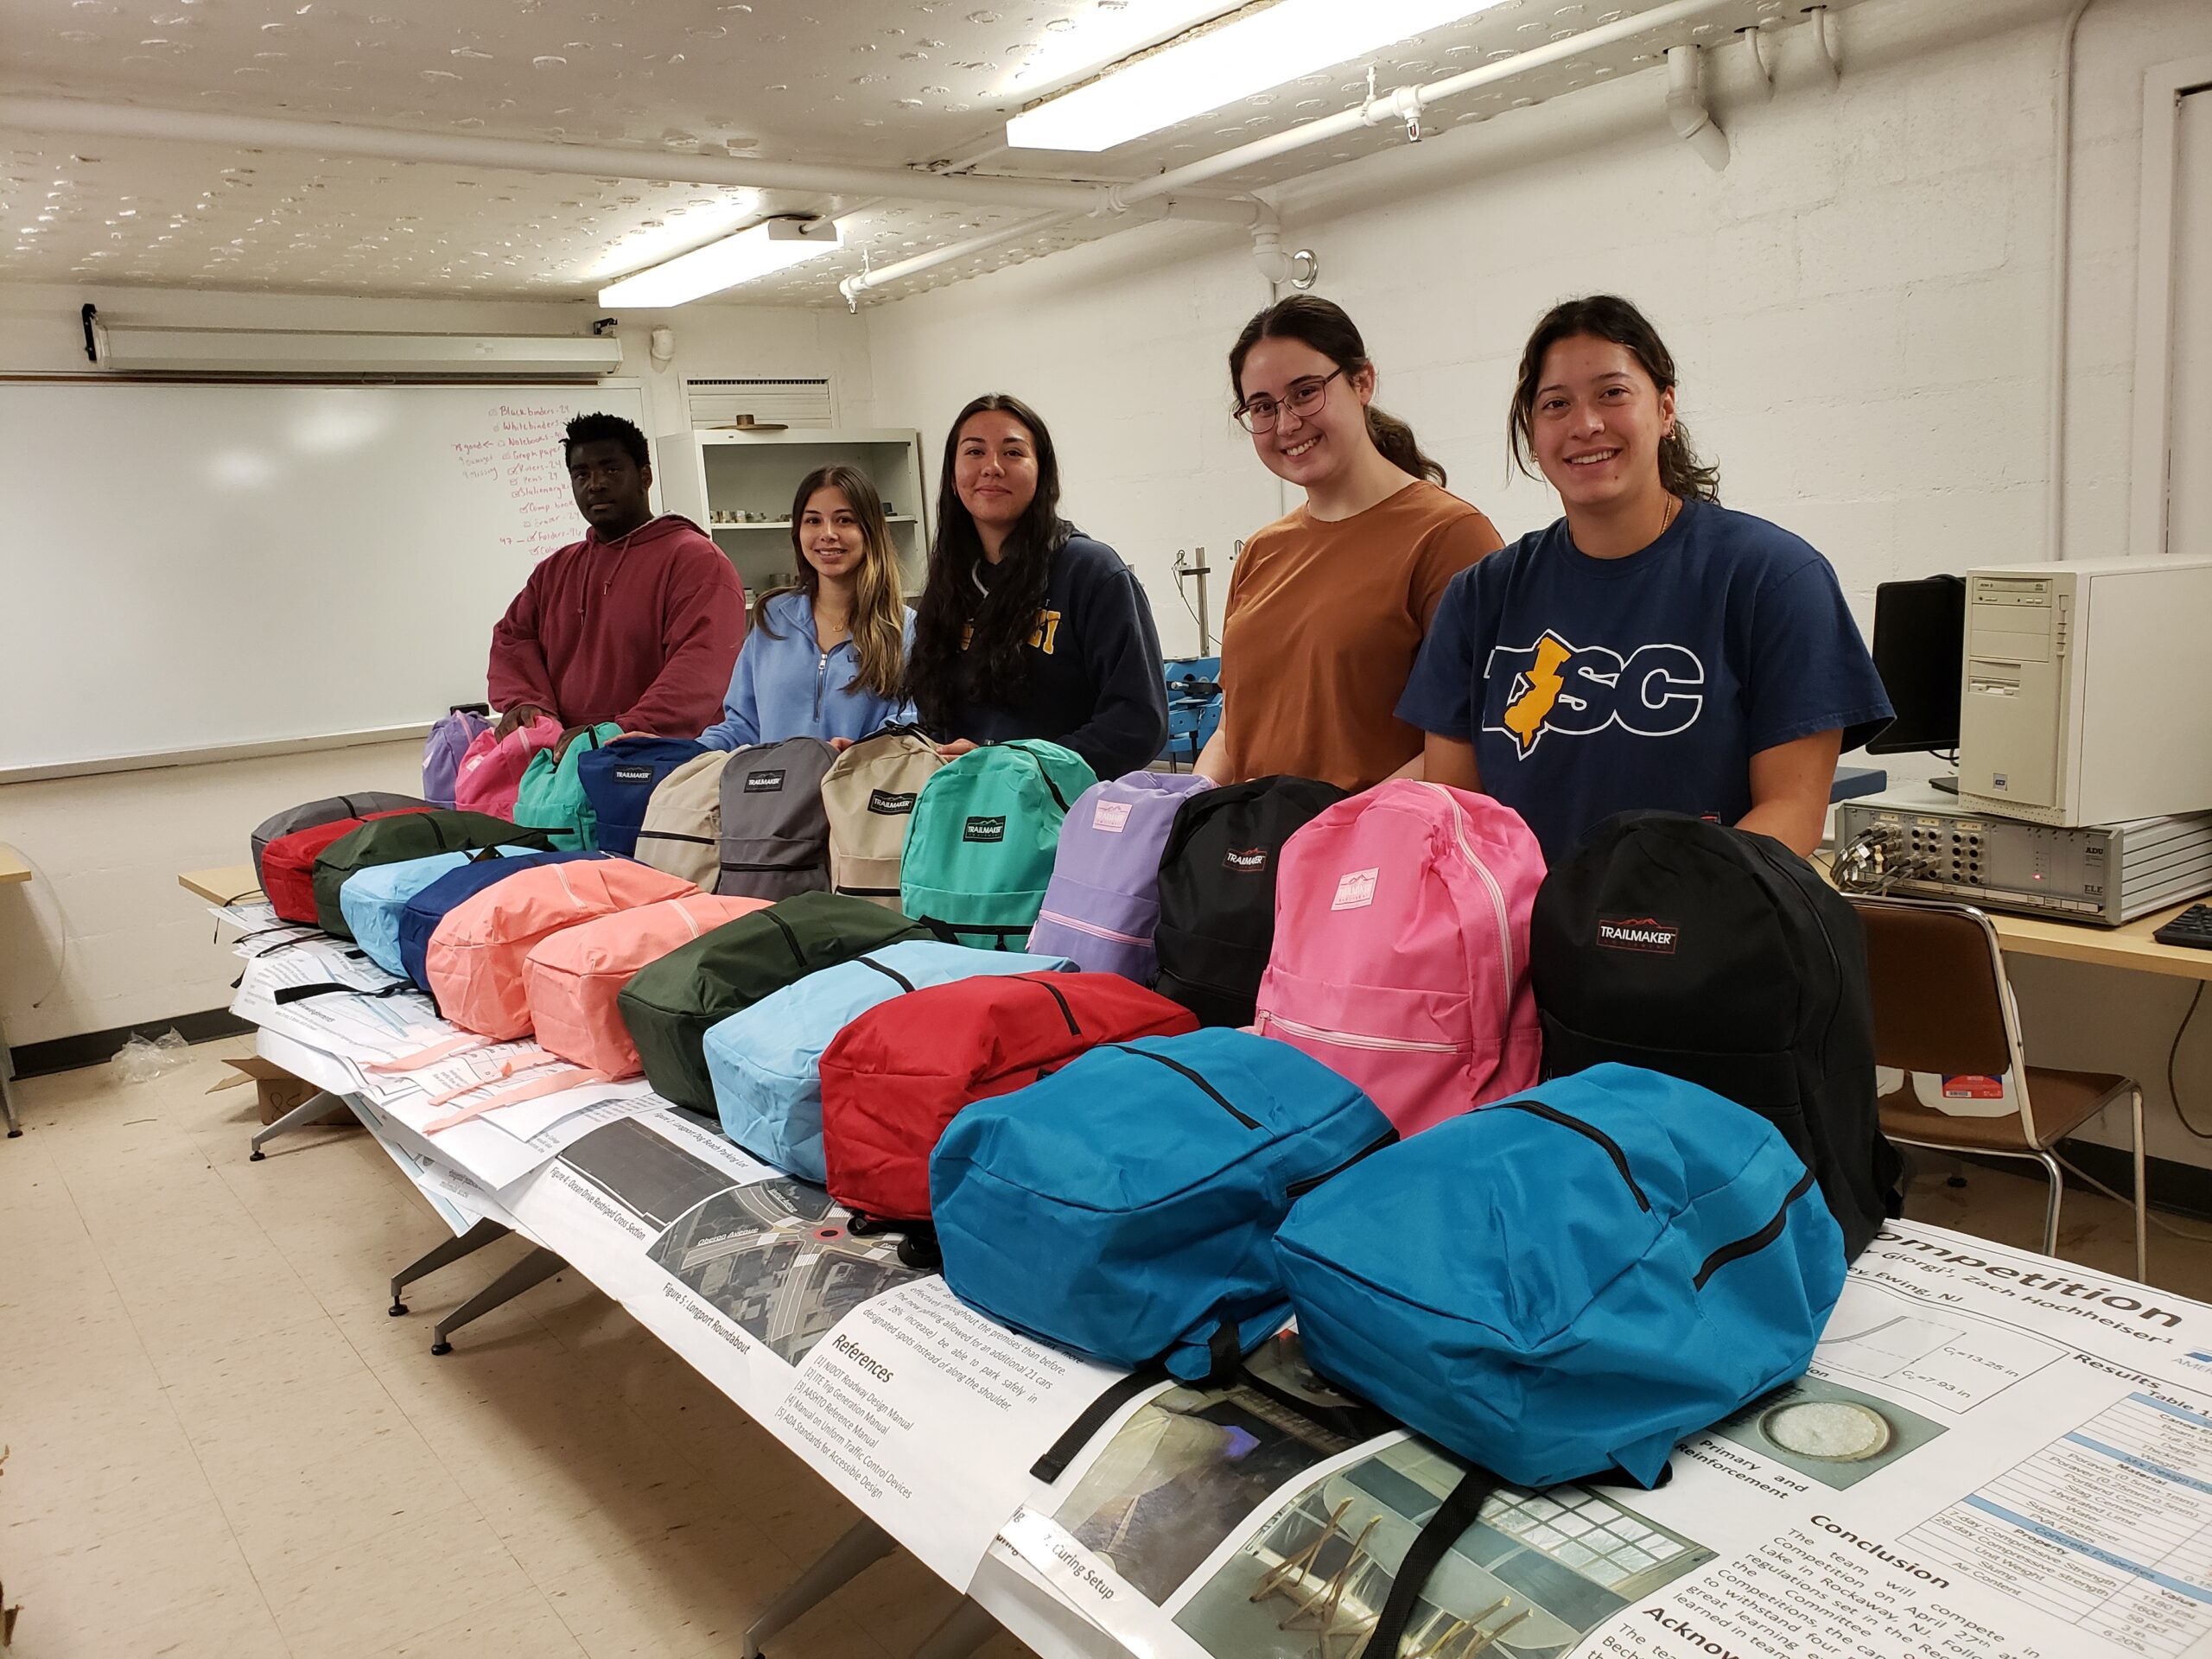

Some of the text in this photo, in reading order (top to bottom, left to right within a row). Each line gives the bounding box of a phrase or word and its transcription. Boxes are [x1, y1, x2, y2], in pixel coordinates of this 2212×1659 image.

[874, 798, 912, 809] TRAILMAKER
[968, 825, 1001, 834] TRAILMAKER
[1227, 852, 1265, 865] TRAILMAKER
[2084, 885, 2103, 893] ELE
[1600, 925, 1675, 944] TRAILMAKER
[549, 1166, 646, 1241] Figure Ocean Drive Restriped Cross Section
[697, 1233, 728, 1246] Oberon
[1873, 1230, 2183, 1328] ompetition
[1874, 1271, 1964, 1303] Ewing, NJ
[1961, 1274, 2016, 1298] Zach
[663, 1281, 751, 1356] Figure Longport Roundabout
[831, 1333, 894, 1383] References
[861, 1308, 1011, 1412] designated spots instead along the shoulder.
[903, 1313, 938, 1339] increase)
[937, 1337, 950, 1349] be
[950, 1347, 969, 1361] able
[979, 1365, 1001, 1382] park
[1001, 1378, 1027, 1397] safely
[1027, 1392, 1039, 1404] in
[942, 1319, 974, 1344] allowed
[988, 1347, 1029, 1373] additional
[1034, 1376, 1054, 1389] cars
[988, 1328, 1023, 1351] premises
[1020, 1344, 1040, 1360] than
[1038, 1356, 1067, 1376] before.
[2074, 1354, 2162, 1389] Results
[803, 1386, 880, 1448] AASHTO Reference Manual
[823, 1361, 915, 1431] NJDOT Roadway Design Manual
[832, 1389, 869, 1417] Generation
[864, 1412, 891, 1436] Manual
[2148, 1389, 2194, 1410] Table
[783, 1412, 797, 1427] ADA
[793, 1421, 823, 1449] Standards
[828, 1450, 862, 1480] Accessible
[859, 1475, 884, 1499] Design
[793, 1399, 912, 1499] Manual Uniform Traffic Control Devices
[1674, 1443, 1790, 1500] Reinforcement
[1700, 1439, 1810, 1493] Primary and
[2117, 1463, 2168, 1485] Material
[2050, 1489, 2106, 1514] Hydrated
[2065, 1484, 2142, 1518] Slag Cement
[2066, 1505, 2101, 1523] Water
[1809, 1514, 1951, 1589] Conclusion
[2013, 1529, 2069, 1555] Property
[2029, 1513, 2096, 1544] PVA Fibers
[2034, 1527, 2090, 1554] Concrete
[1052, 1543, 1085, 1577] Curing
[1082, 1568, 1116, 1601] Setup
[1935, 1516, 2110, 1598] 28-day Compressive strength
[1950, 1561, 2022, 1596] Air Content
[1974, 1546, 2046, 1581] Unit Weight
[1977, 1560, 2018, 1583] Slump
[1983, 1525, 2062, 1564] Compressive
[2063, 1561, 2118, 1588] Strength
[1717, 1569, 1853, 1644] Competitions, the
[1732, 1560, 1872, 1637] the Committee
[1745, 1553, 1915, 1646] regulations set in the
[1758, 1544, 1793, 1566] Lake
[1798, 1563, 1815, 1577] in
[1821, 1577, 1899, 1623] Rockaway,
[1773, 1535, 1866, 1589] Competition
[1873, 1590, 1896, 1604] on
[1904, 1605, 1948, 1629] April
[1786, 1528, 1815, 1546] The
[1829, 1551, 1869, 1576] team
[1885, 1580, 1916, 1598] will
[1929, 1603, 2006, 1643] compete
[1618, 1623, 1646, 1645] The
[1672, 1592, 1748, 1639] learned in
[1685, 1585, 1729, 1611] great
[1734, 1610, 1801, 1650] learning
[1703, 1576, 1720, 1589] to
[1725, 1588, 1802, 1633] withstand
[1804, 1631, 1842, 1655] four
